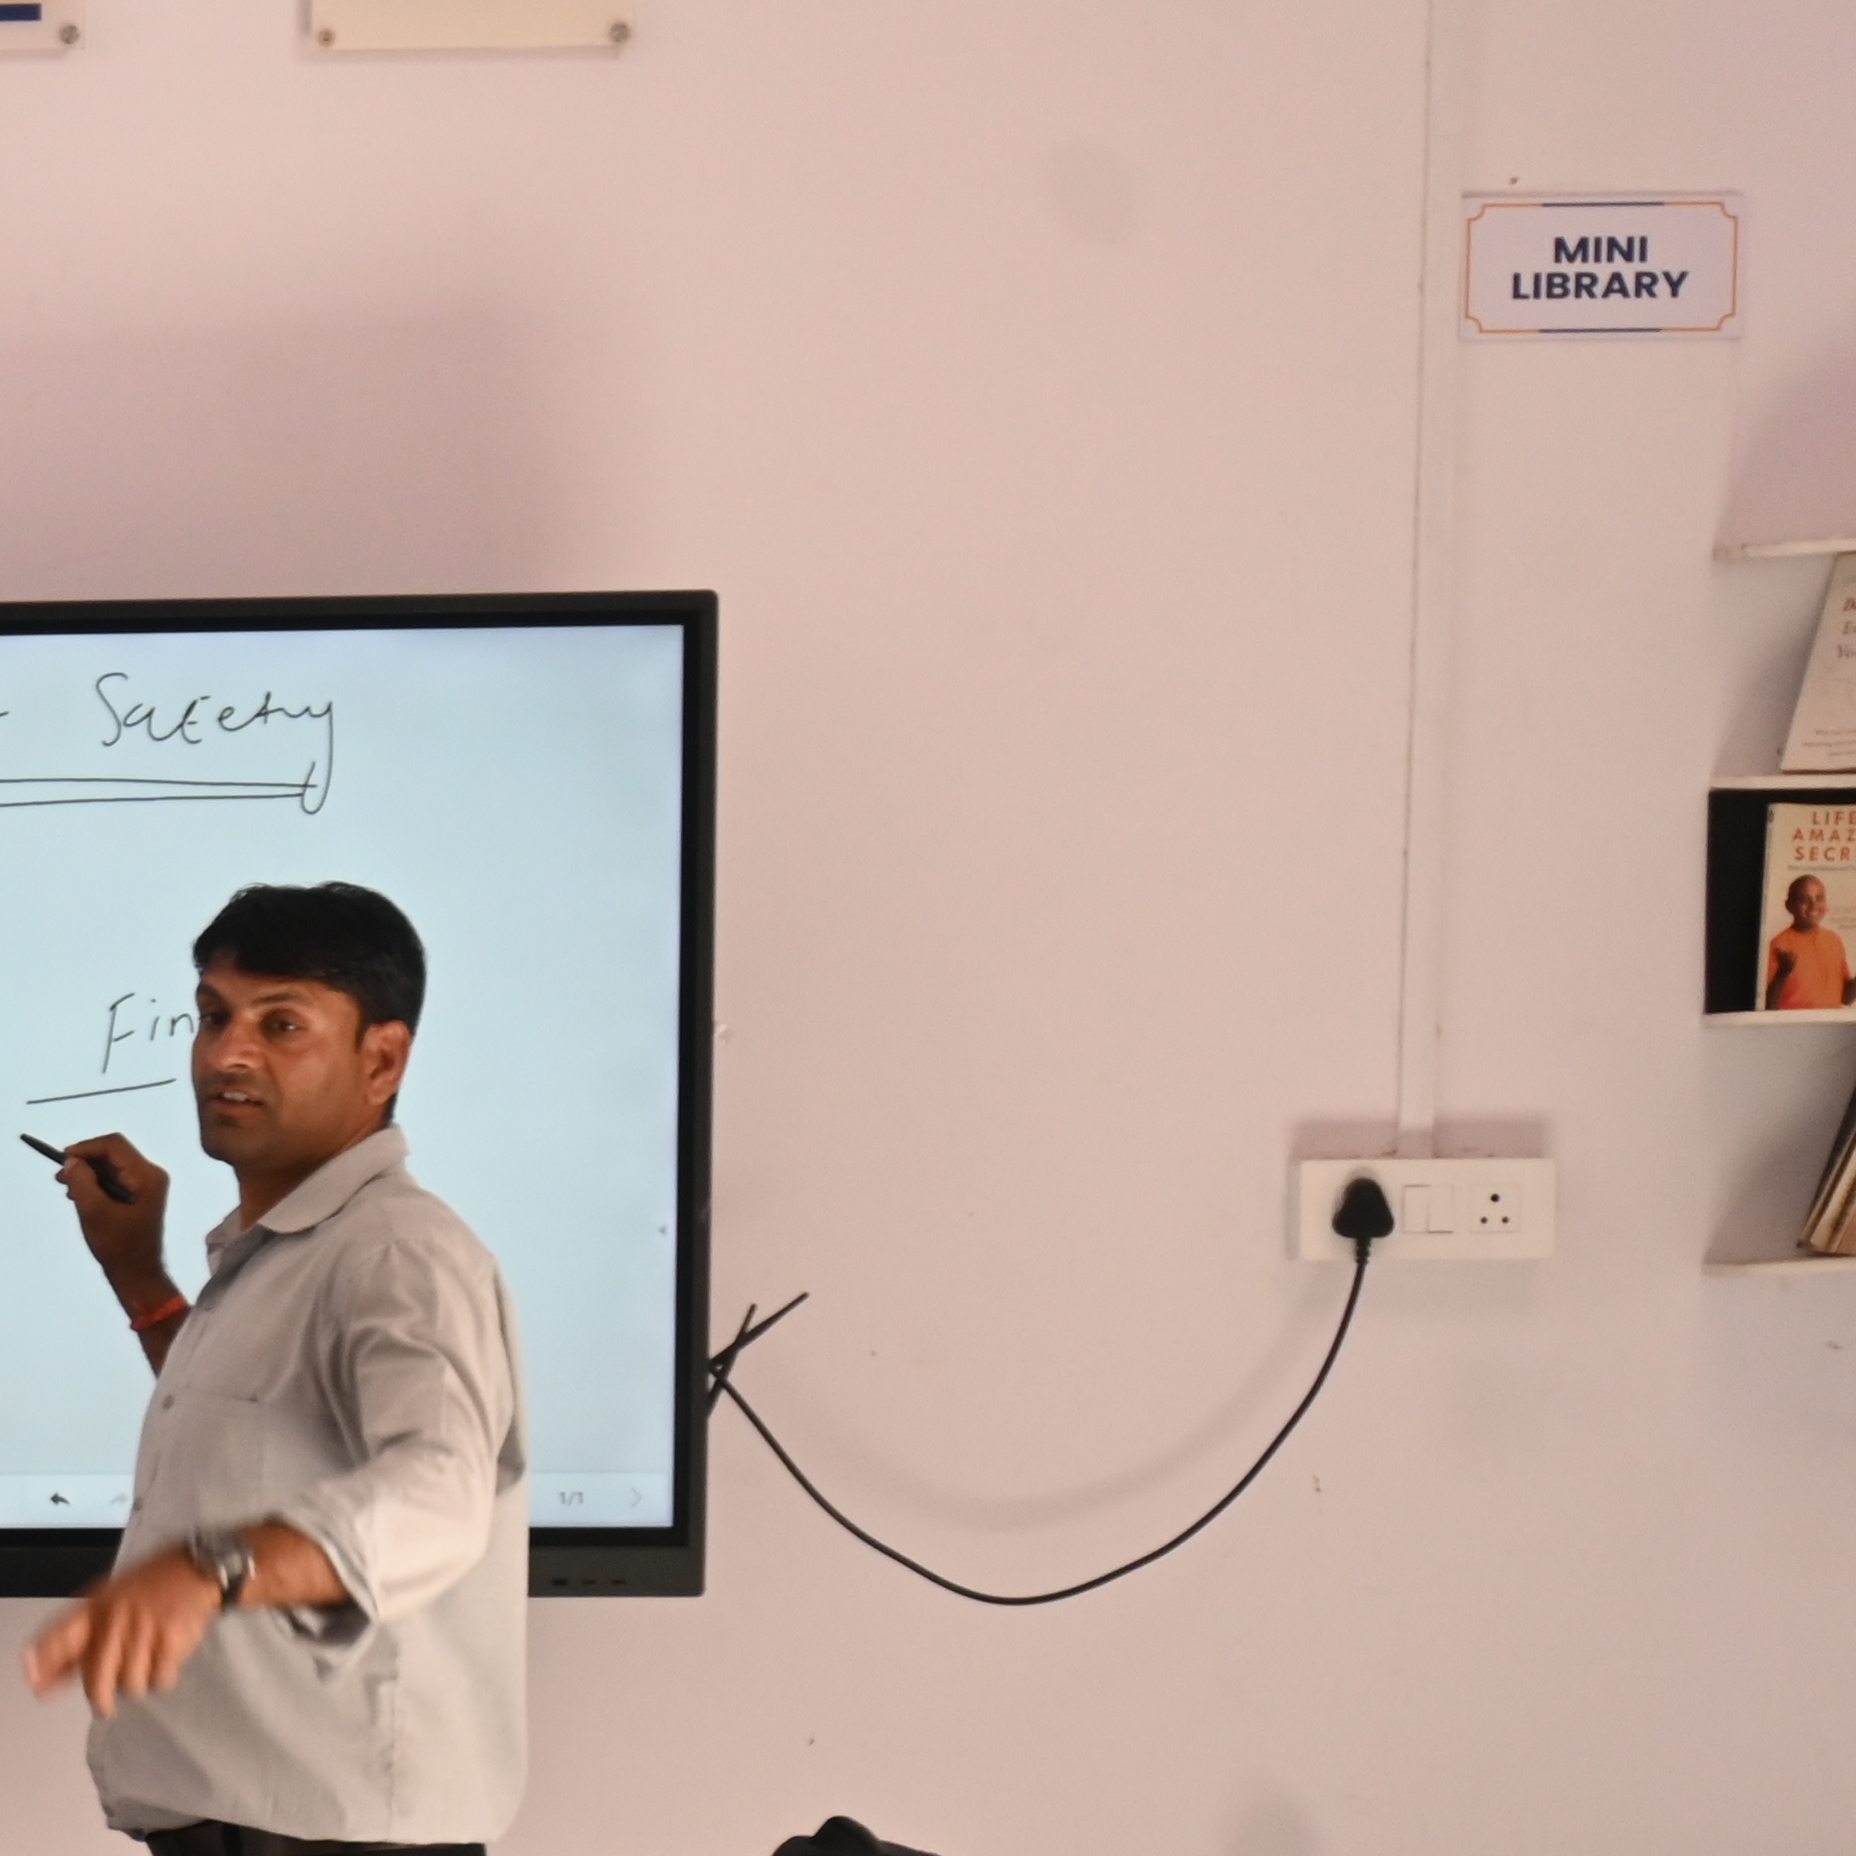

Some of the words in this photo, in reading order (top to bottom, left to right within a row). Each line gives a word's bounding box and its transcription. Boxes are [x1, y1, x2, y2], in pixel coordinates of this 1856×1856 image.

[1553, 235, 1649, 265] MINI
[1511, 270, 1690, 300] LIBRARY
[1794, 845, 1856, 862] SECR
